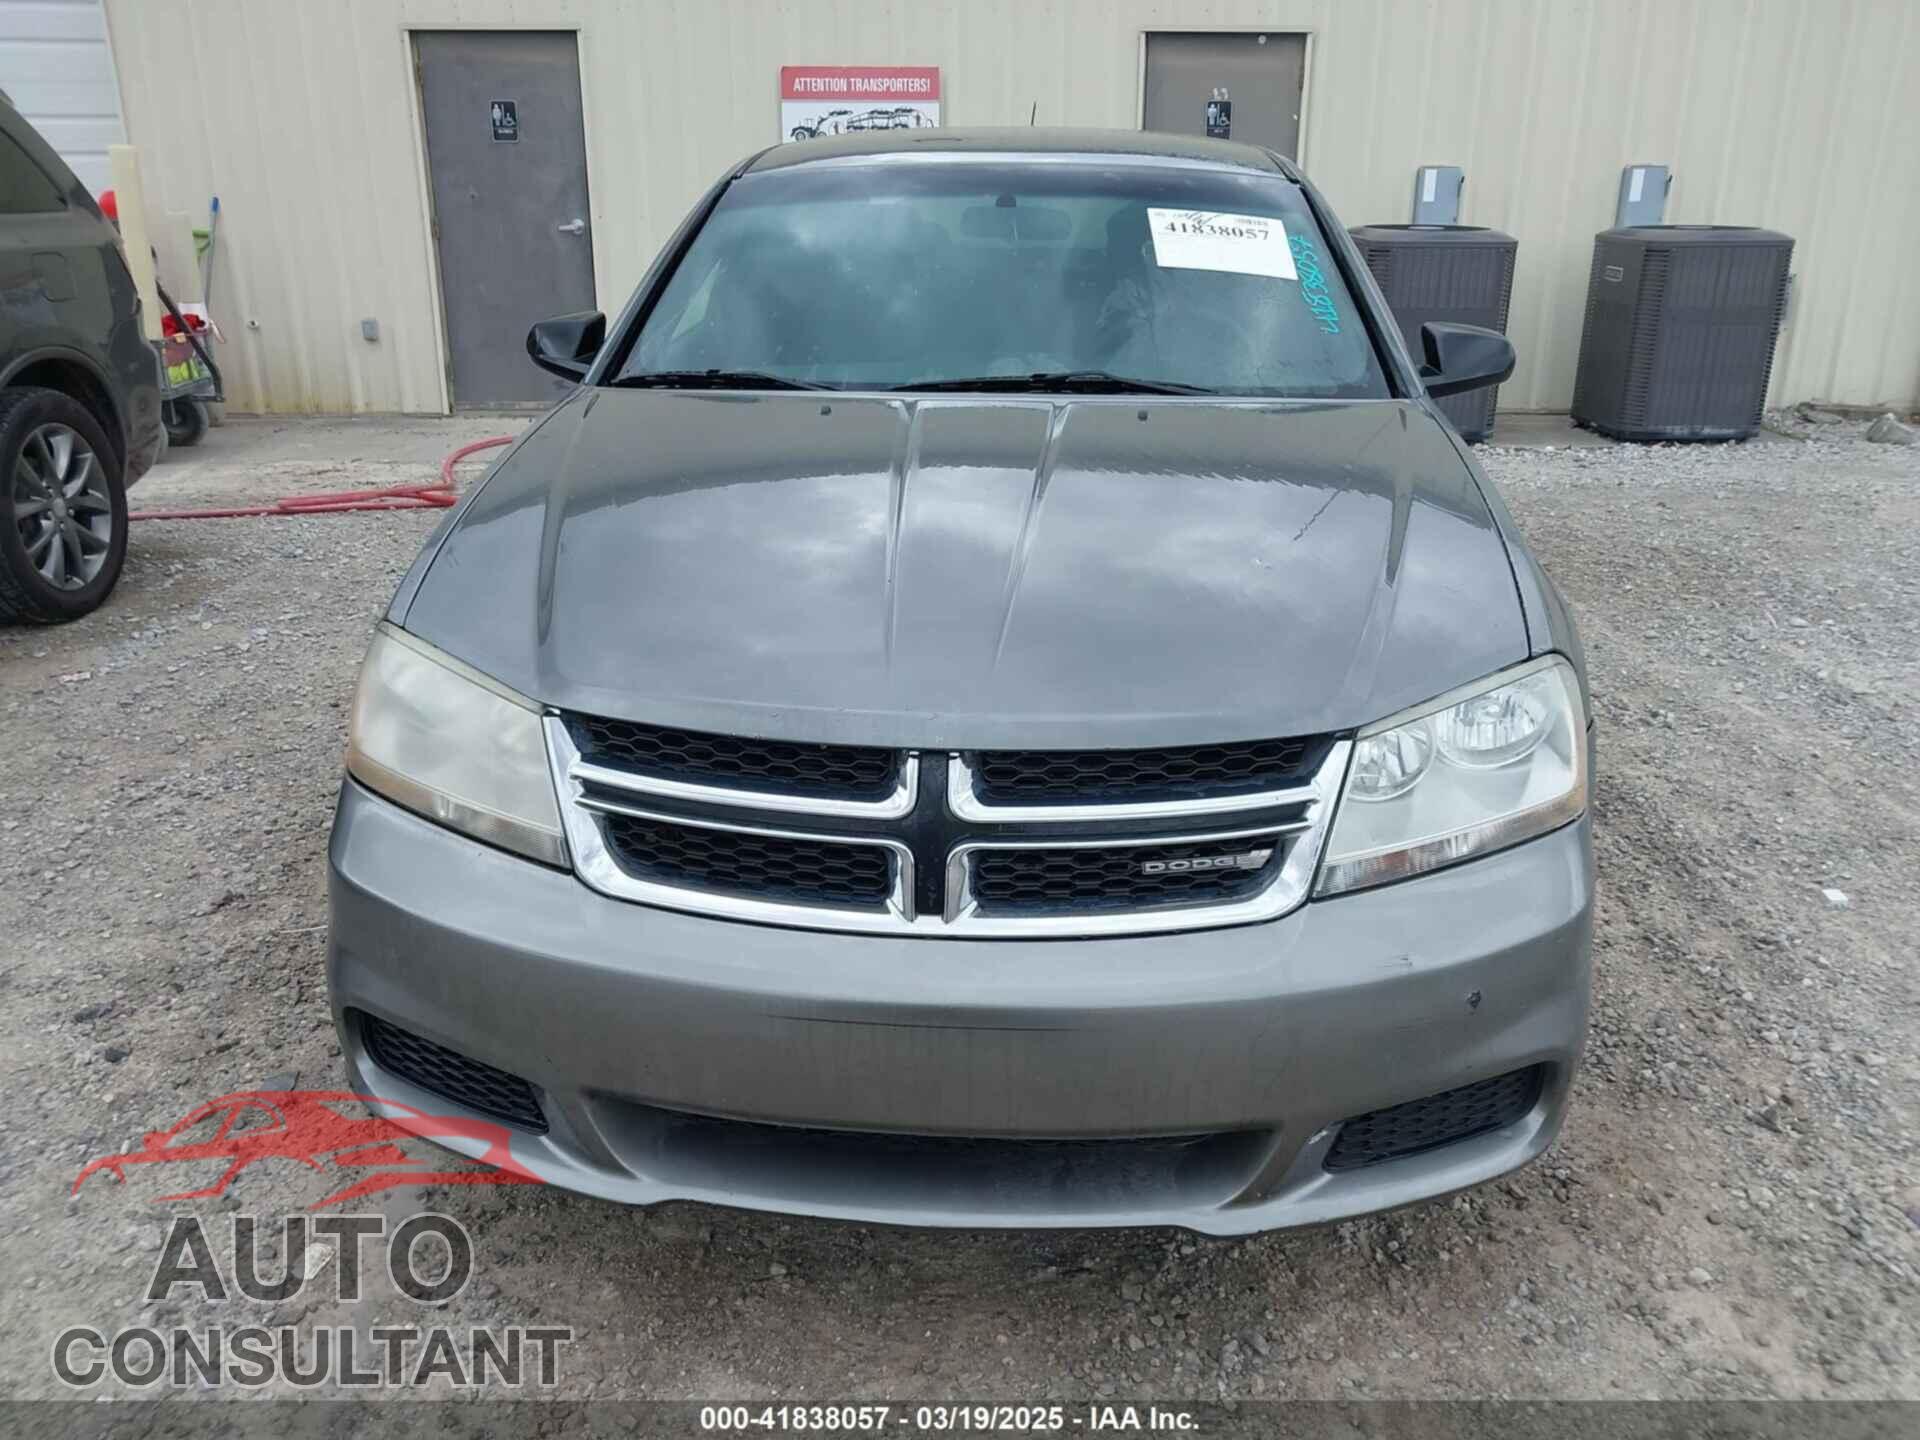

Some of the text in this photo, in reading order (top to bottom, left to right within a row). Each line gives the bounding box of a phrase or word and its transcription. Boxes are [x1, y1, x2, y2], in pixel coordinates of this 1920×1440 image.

[793, 77, 931, 92] ATTENTION TRANSPORTERS!
[1165, 221, 1270, 240] 41838057
